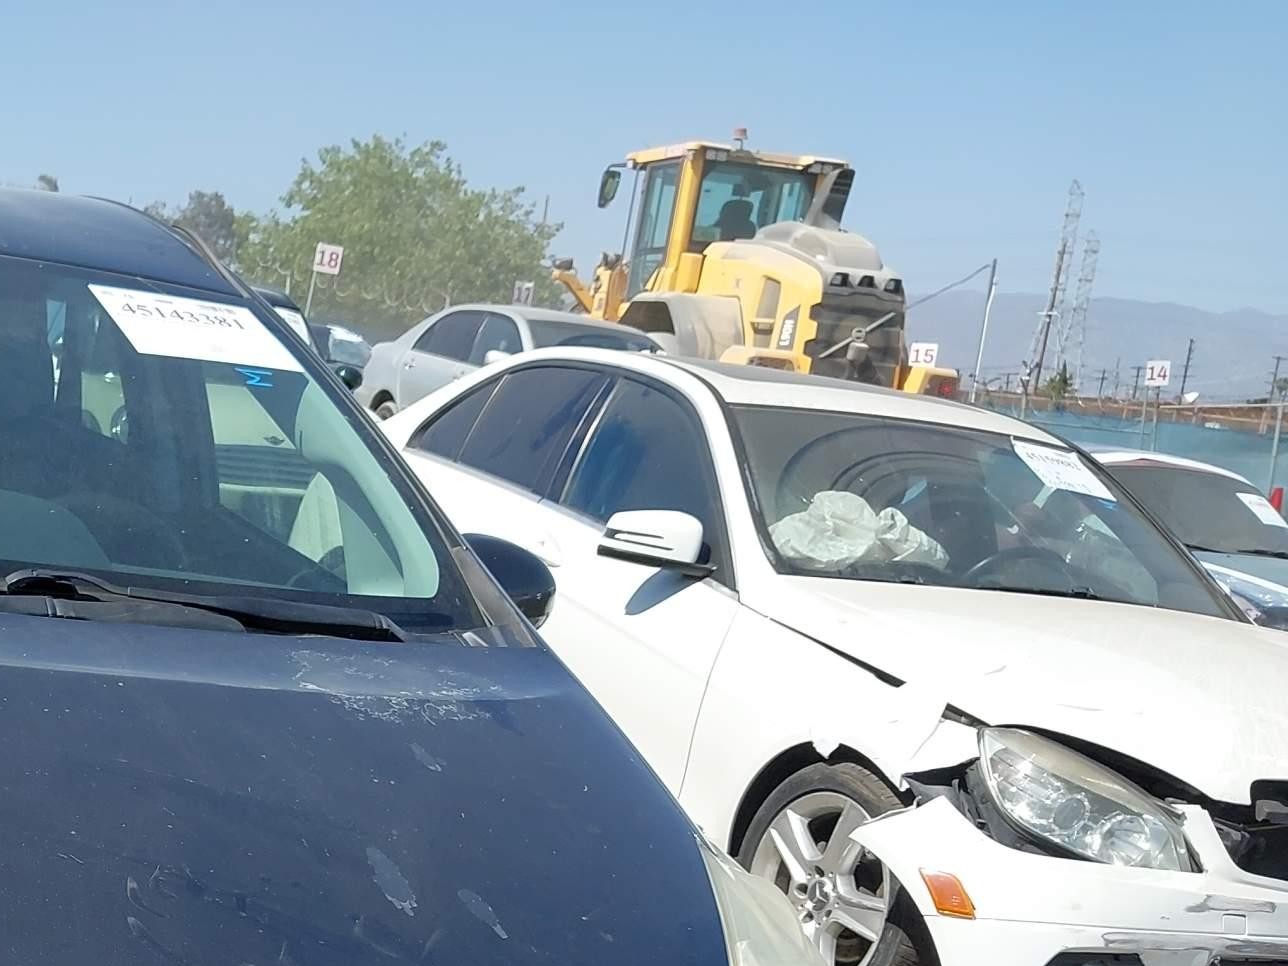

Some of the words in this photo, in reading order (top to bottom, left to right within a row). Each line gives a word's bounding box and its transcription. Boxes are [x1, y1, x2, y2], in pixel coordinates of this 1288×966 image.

[316, 250, 340, 269] 18
[121, 302, 245, 331] 45143381
[911, 349, 934, 364] 15
[1147, 366, 1168, 381] 14
